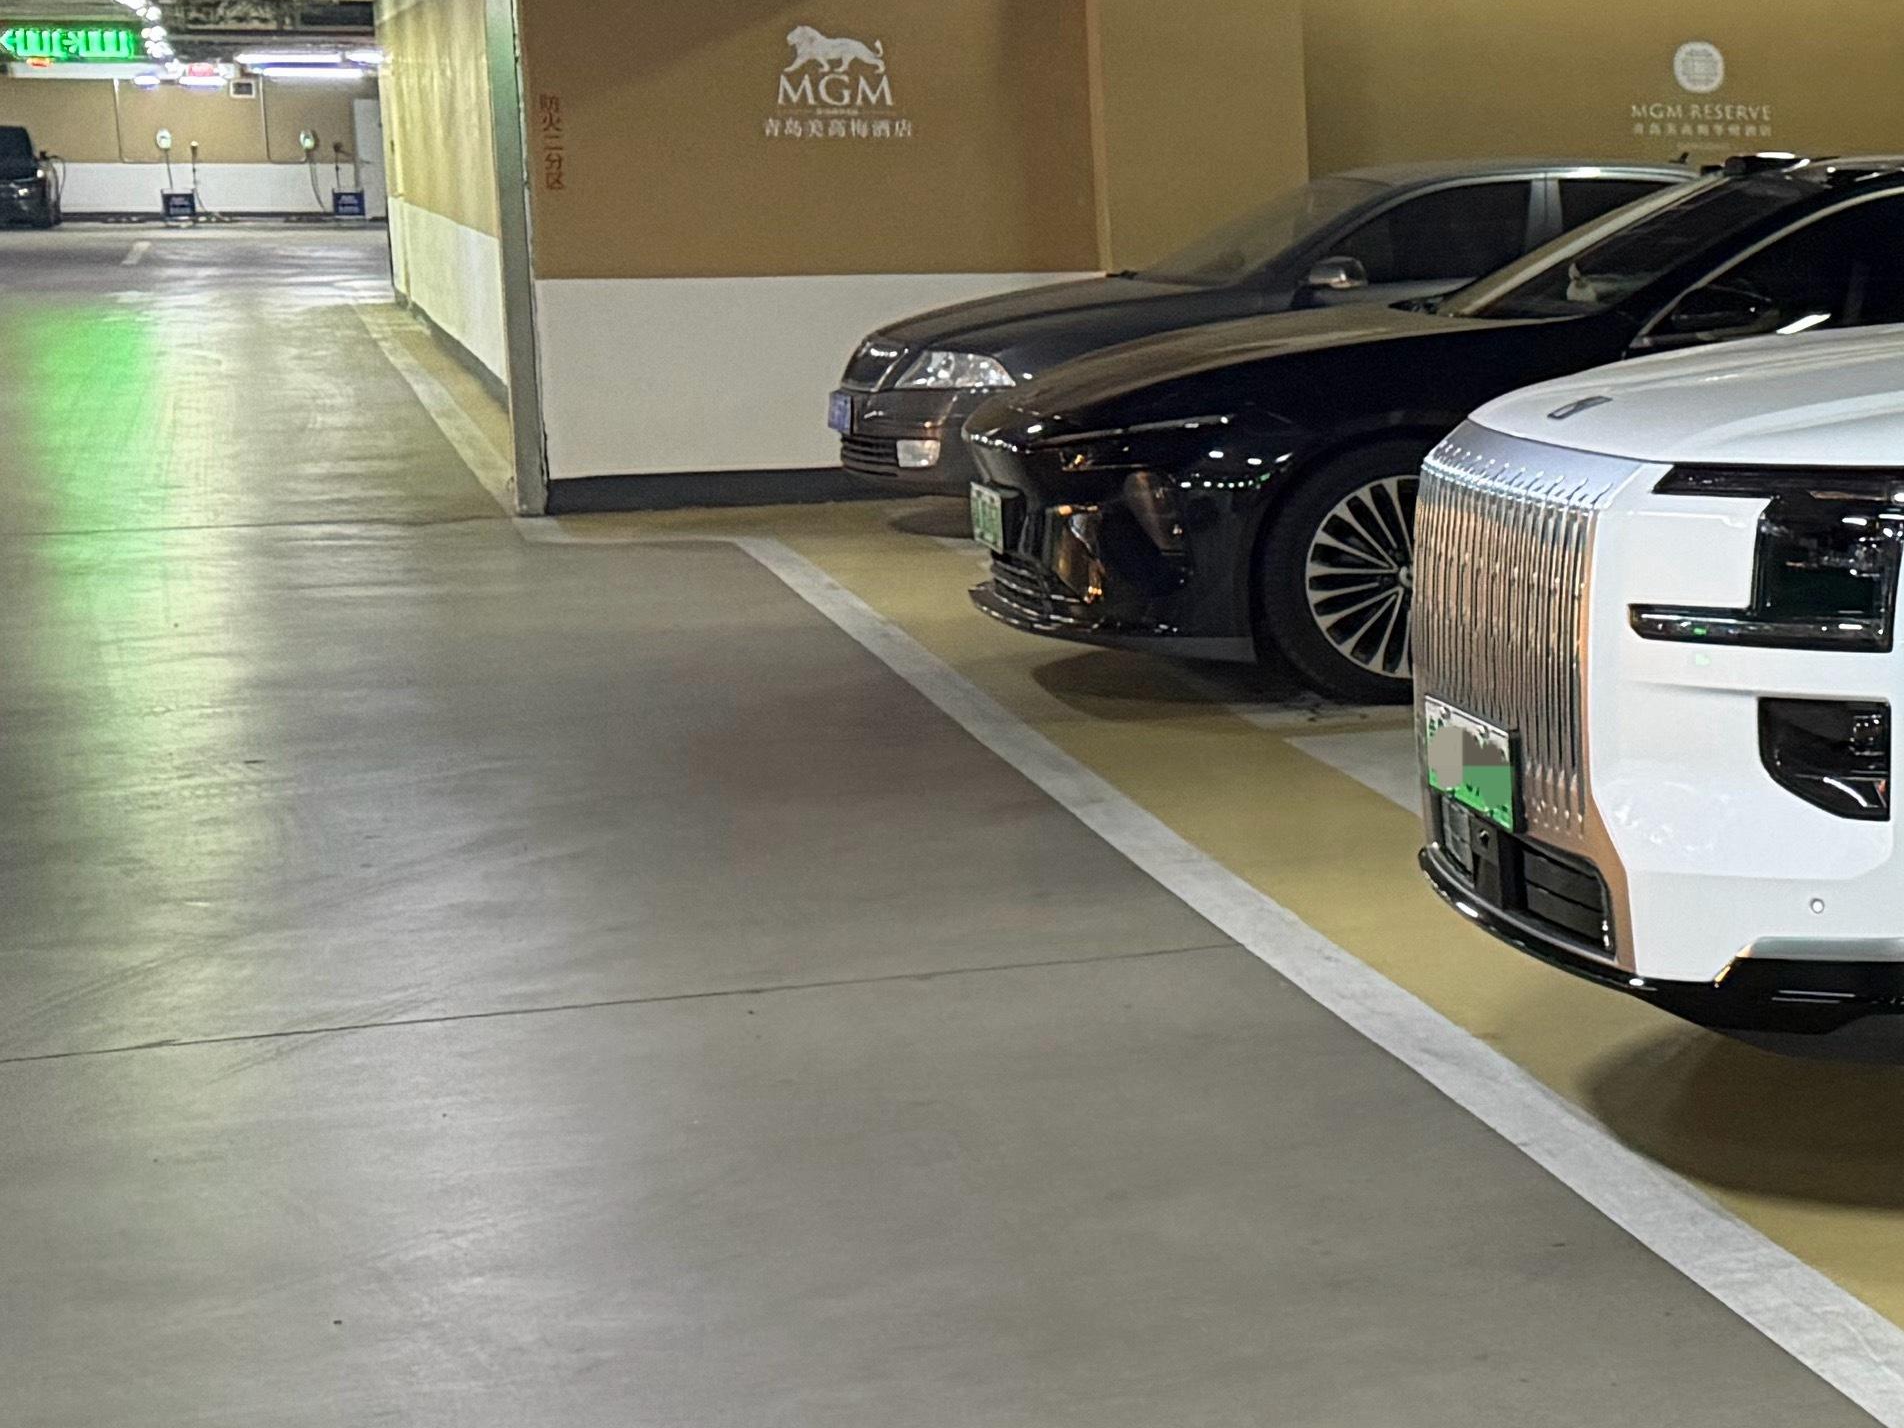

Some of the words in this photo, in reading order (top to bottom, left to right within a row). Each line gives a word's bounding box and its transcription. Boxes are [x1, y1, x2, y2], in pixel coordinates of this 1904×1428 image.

[778, 73, 893, 106] MGM
[1631, 103, 1683, 120] MGM
[1690, 104, 1772, 121] RESERVE
